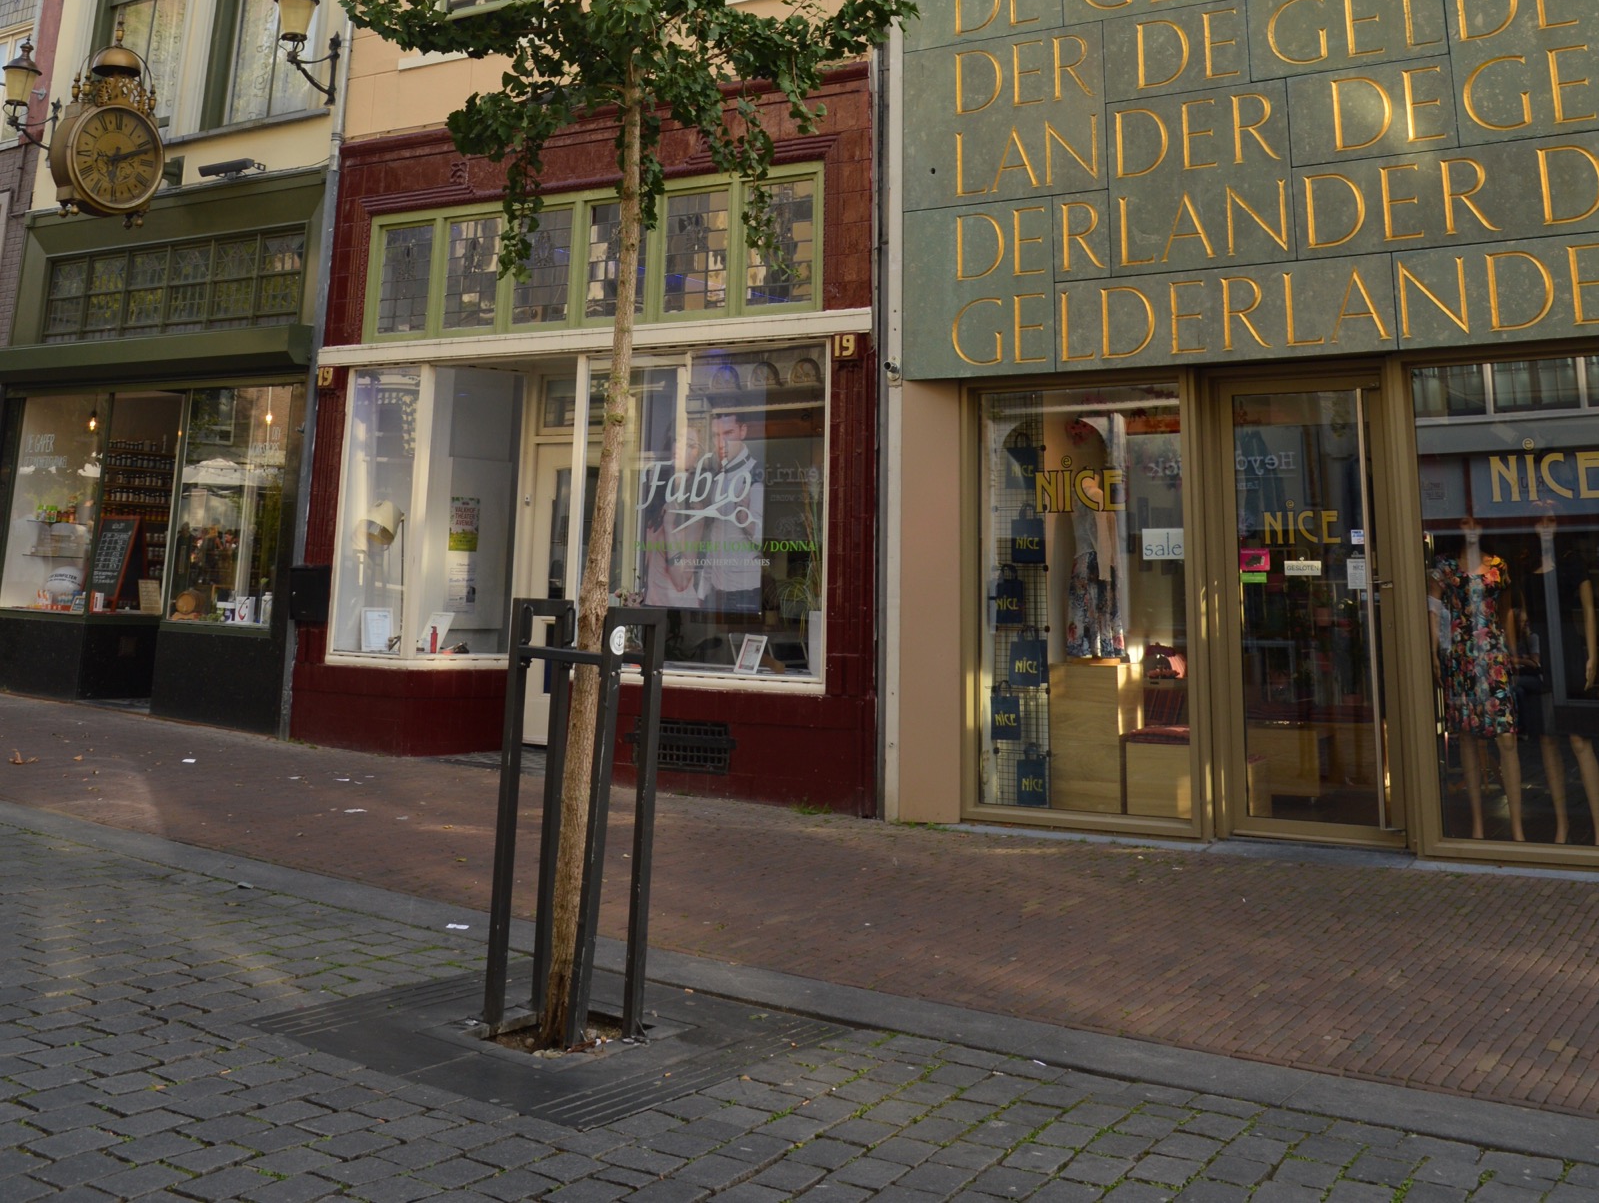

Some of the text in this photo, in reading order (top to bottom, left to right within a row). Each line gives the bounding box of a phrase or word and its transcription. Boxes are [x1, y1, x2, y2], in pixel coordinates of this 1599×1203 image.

[956, 35, 1095, 115] DER
[1137, 8, 1242, 89] DE
[956, 93, 1281, 197] LANDER
[956, 158, 1501, 282] DERLANDER
[834, 333, 856, 357] 19
[317, 366, 334, 387] 19
[636, 452, 752, 510] Fabio
[1488, 451, 1599, 503] NICE
[1035, 468, 1126, 514] NICE
[1263, 508, 1341, 545] NICE
[770, 540, 817, 552] DONNA
[1016, 535, 1039, 549] NICE
[1144, 531, 1182, 556] sale
[674, 558, 711, 566] KAPSALON
[995, 595, 1019, 610] NICE
[1014, 658, 1038, 674] NICE
[995, 712, 1017, 727] NICE
[1021, 776, 1044, 792] NICE
